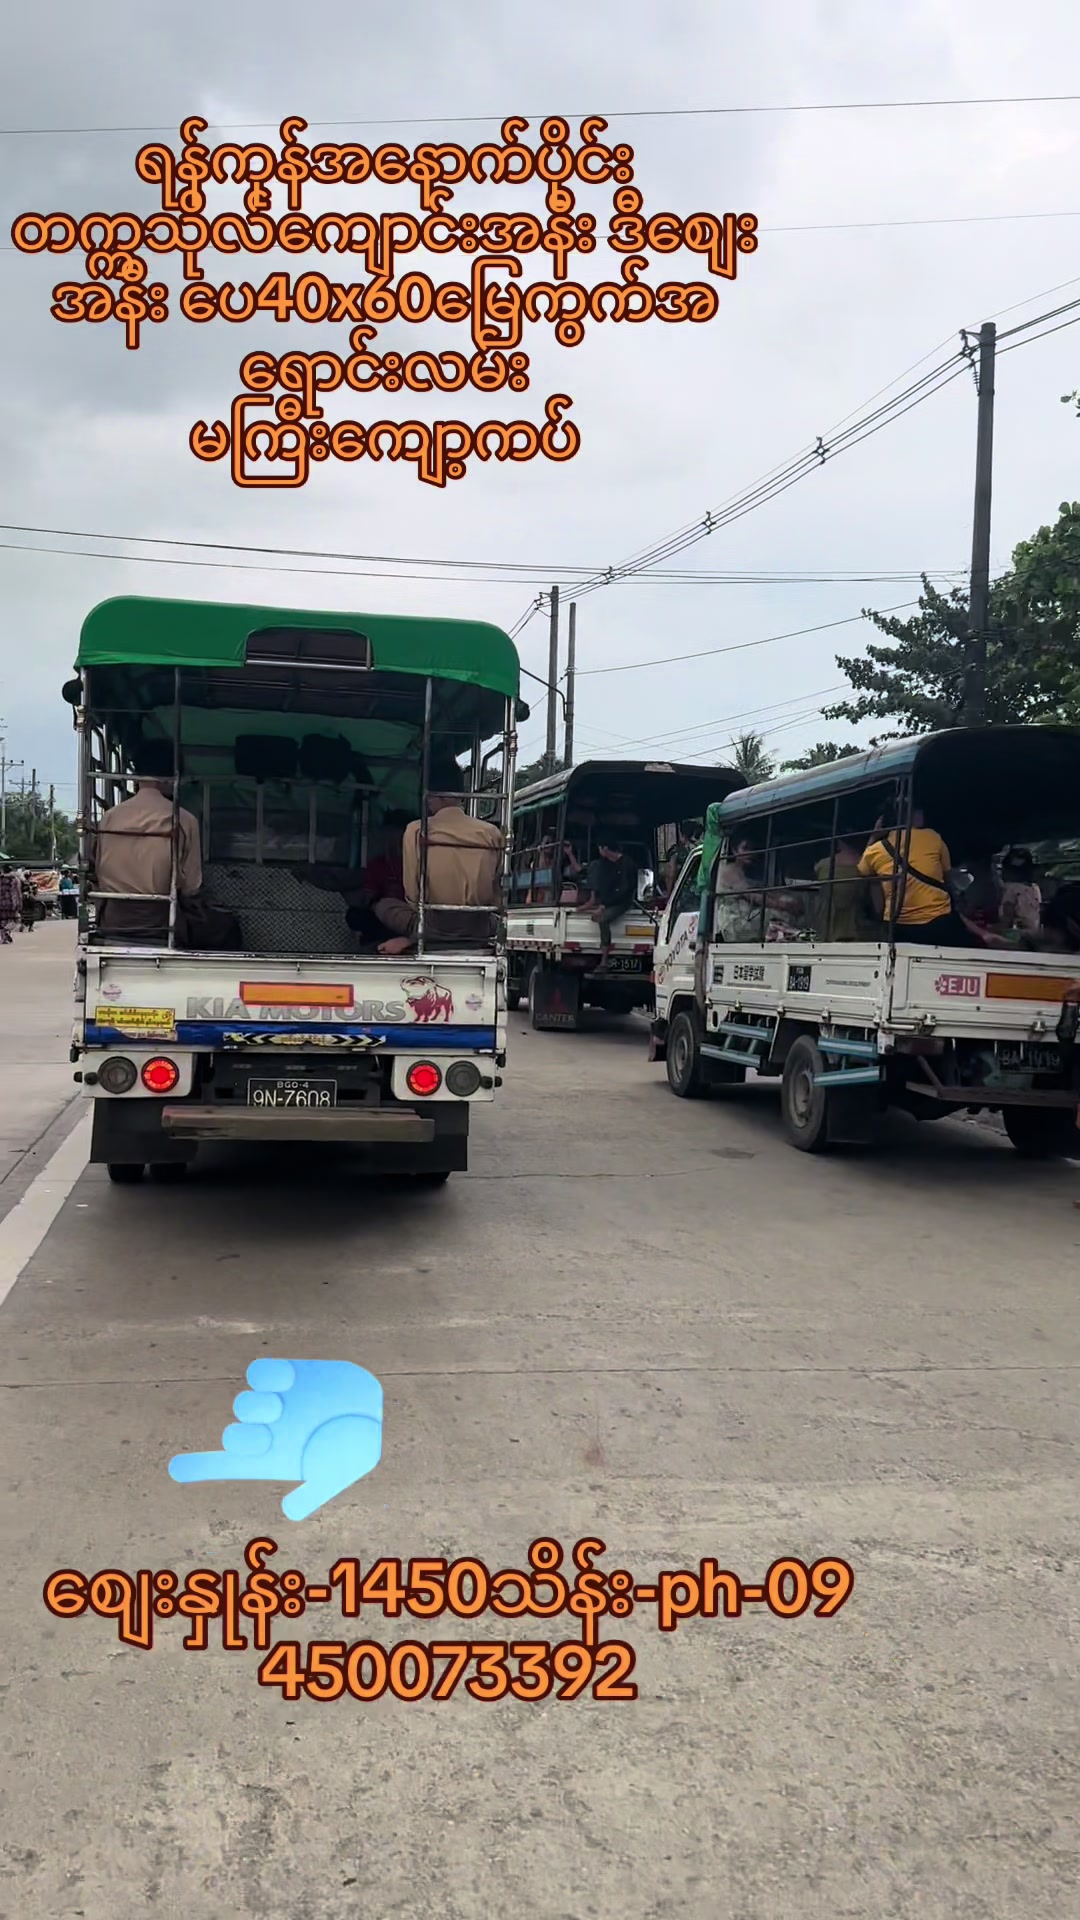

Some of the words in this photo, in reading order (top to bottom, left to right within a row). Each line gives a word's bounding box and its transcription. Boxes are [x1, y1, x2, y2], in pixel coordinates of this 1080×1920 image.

[665, 931, 688, 971] TOYOTA
[948, 978, 978, 995] EJU
[186, 997, 251, 1019] KIA
[259, 1000, 407, 1022] MOTORS
[535, 1012, 575, 1023] CANTER
[253, 1089, 331, 1108] 9N-7608
